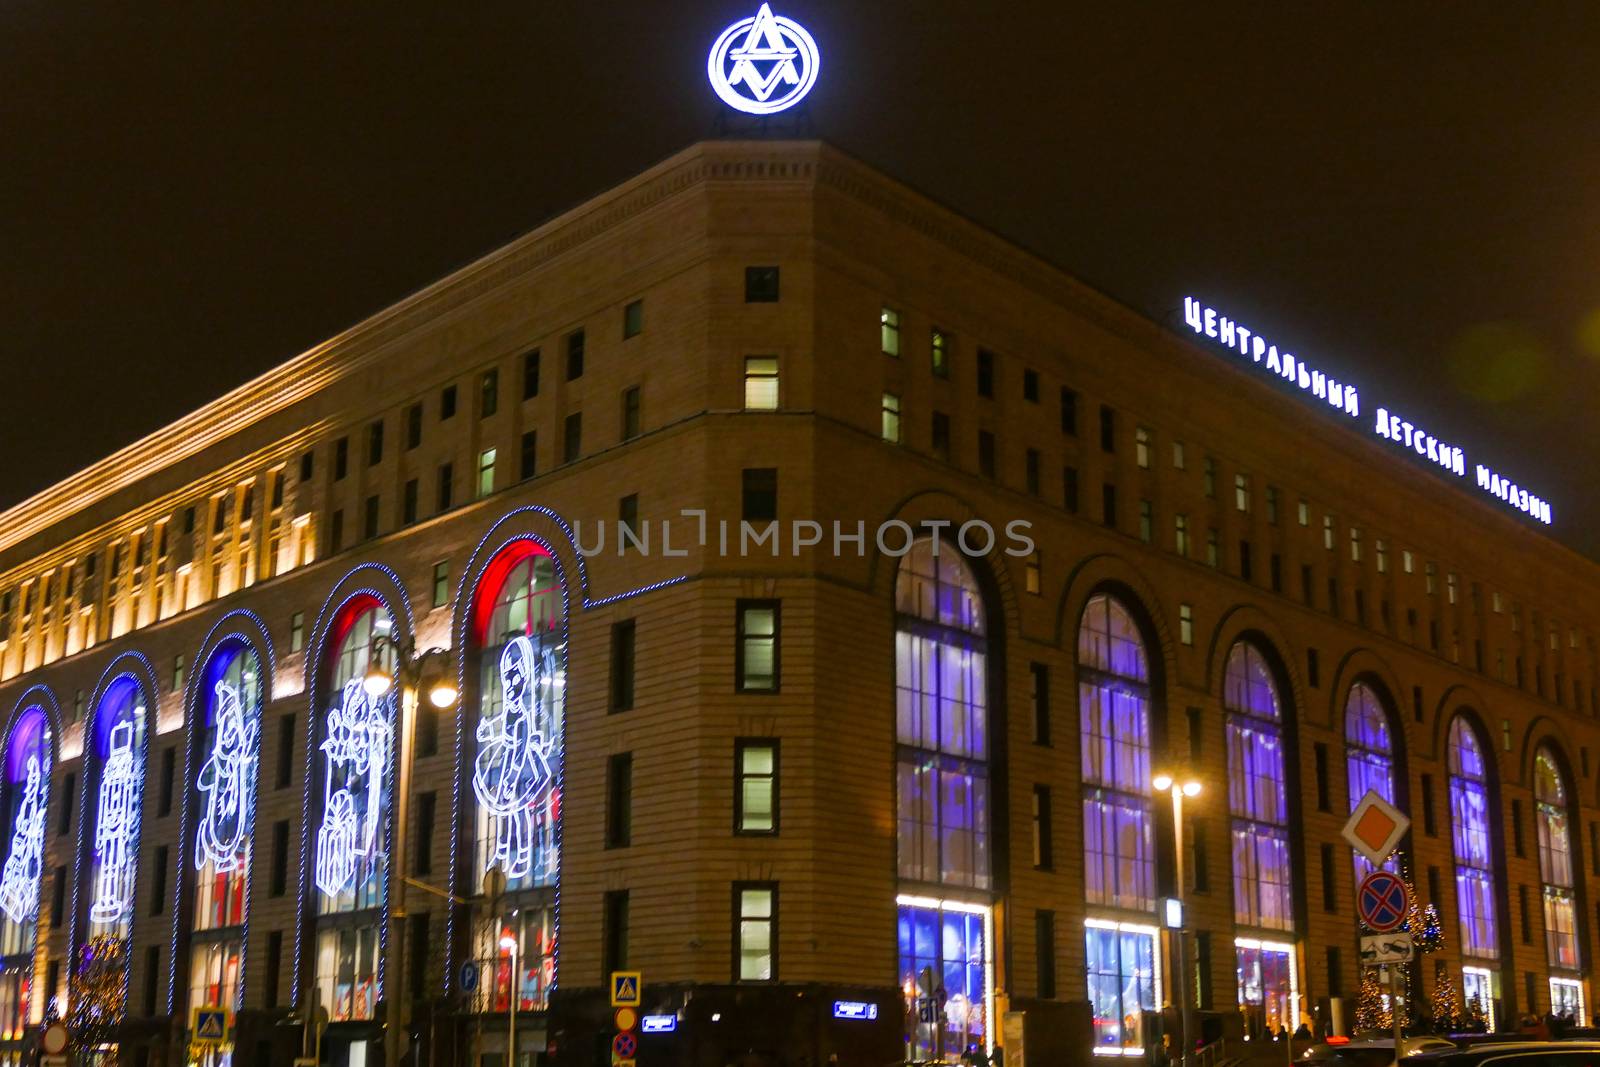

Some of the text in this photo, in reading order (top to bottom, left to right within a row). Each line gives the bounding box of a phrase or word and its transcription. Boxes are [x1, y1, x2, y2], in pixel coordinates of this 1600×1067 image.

[1184, 296, 1552, 525] ЦЕНТРАЛЬНЫЙ ДЕТСКИЙ МАГАЗИН
